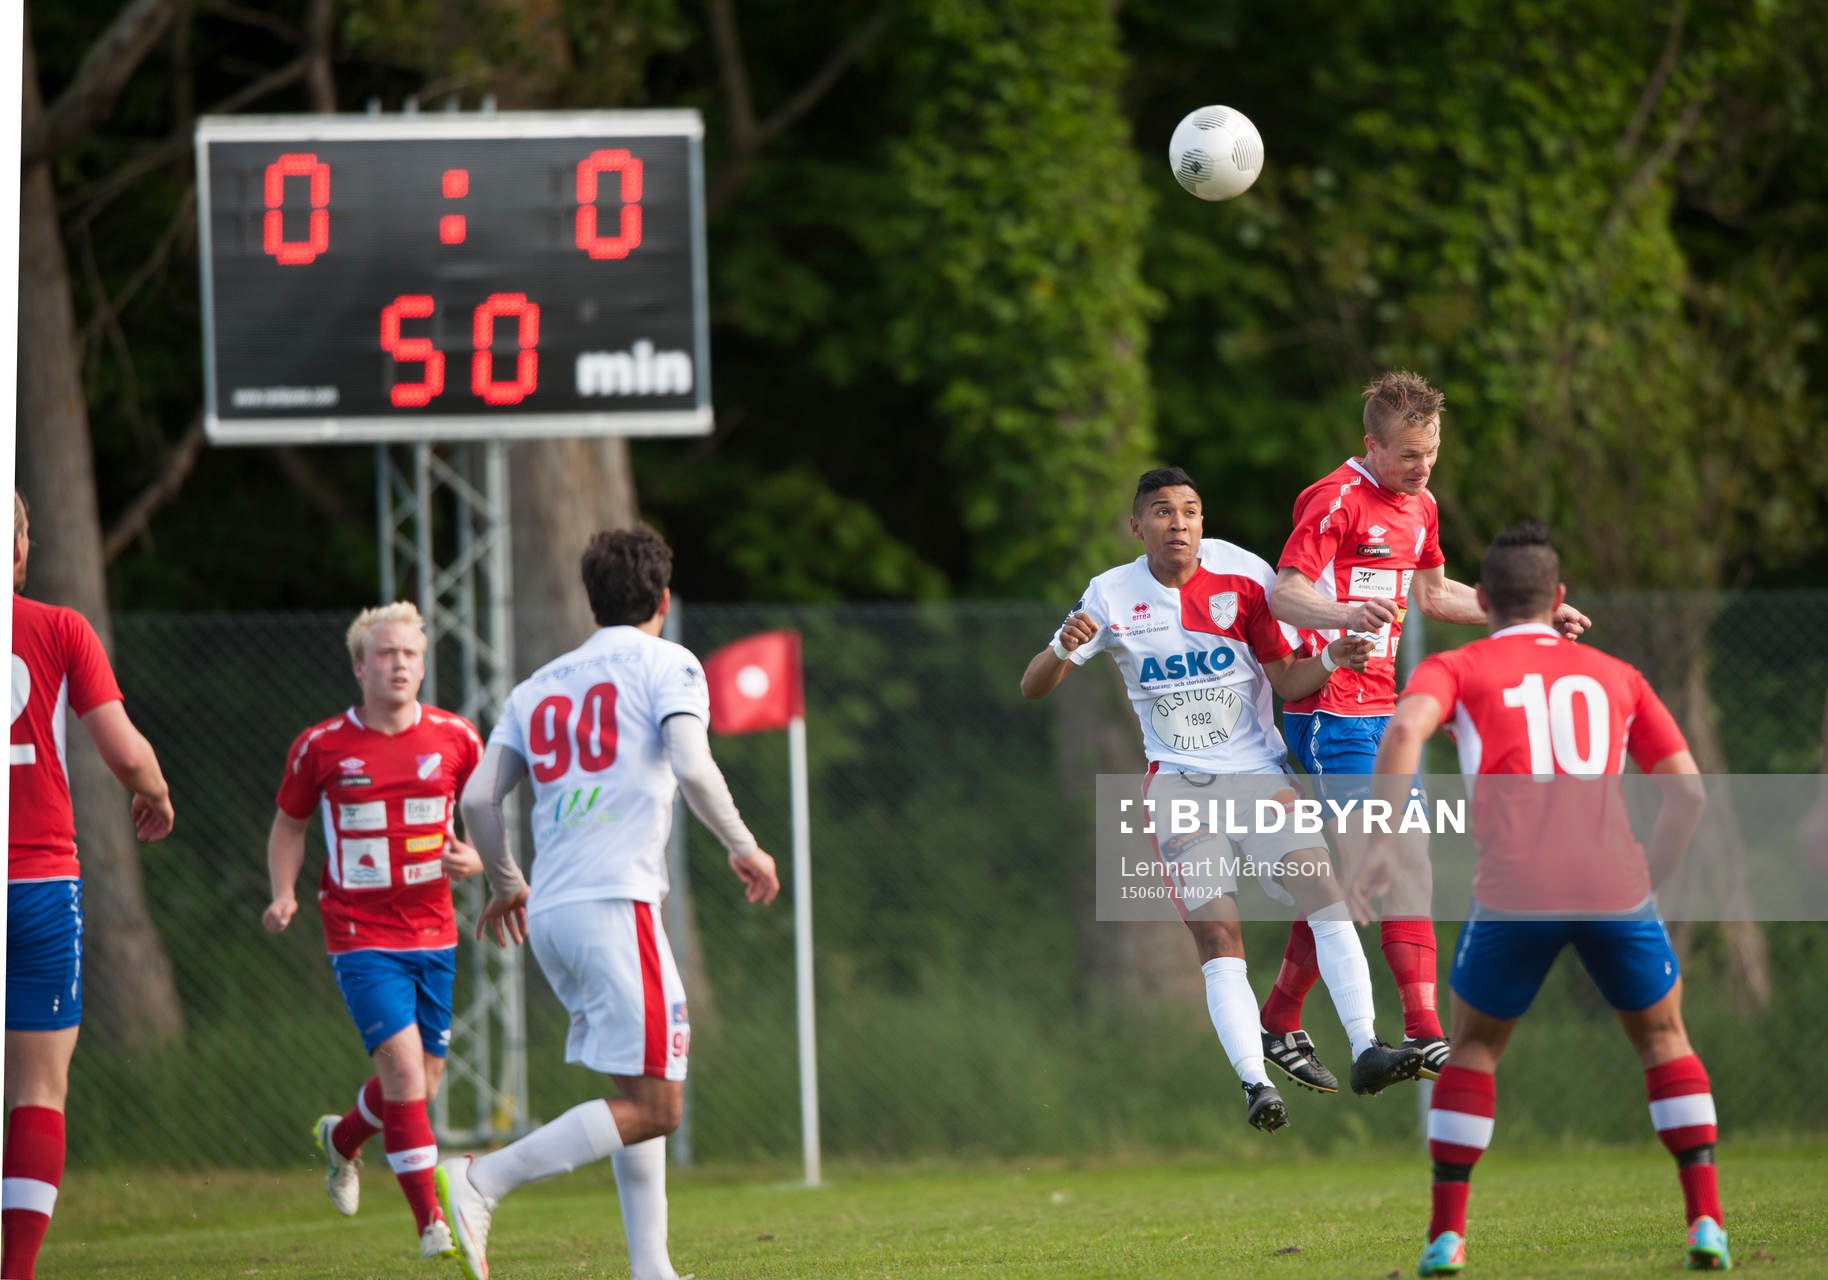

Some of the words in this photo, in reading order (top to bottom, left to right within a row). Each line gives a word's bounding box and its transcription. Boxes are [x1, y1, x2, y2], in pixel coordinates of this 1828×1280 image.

[263, 152, 330, 265] 0
[575, 148, 644, 260] 0
[380, 292, 540, 407] 50
[575, 339, 694, 397] min
[1139, 646, 1235, 683] ASKO
[529, 681, 618, 785] 90
[1156, 687, 1237, 718] ÖLSTUGAN
[1184, 711, 1212, 727] 1892
[1502, 673, 1610, 783] 10
[1173, 728, 1230, 750] TULLEN
